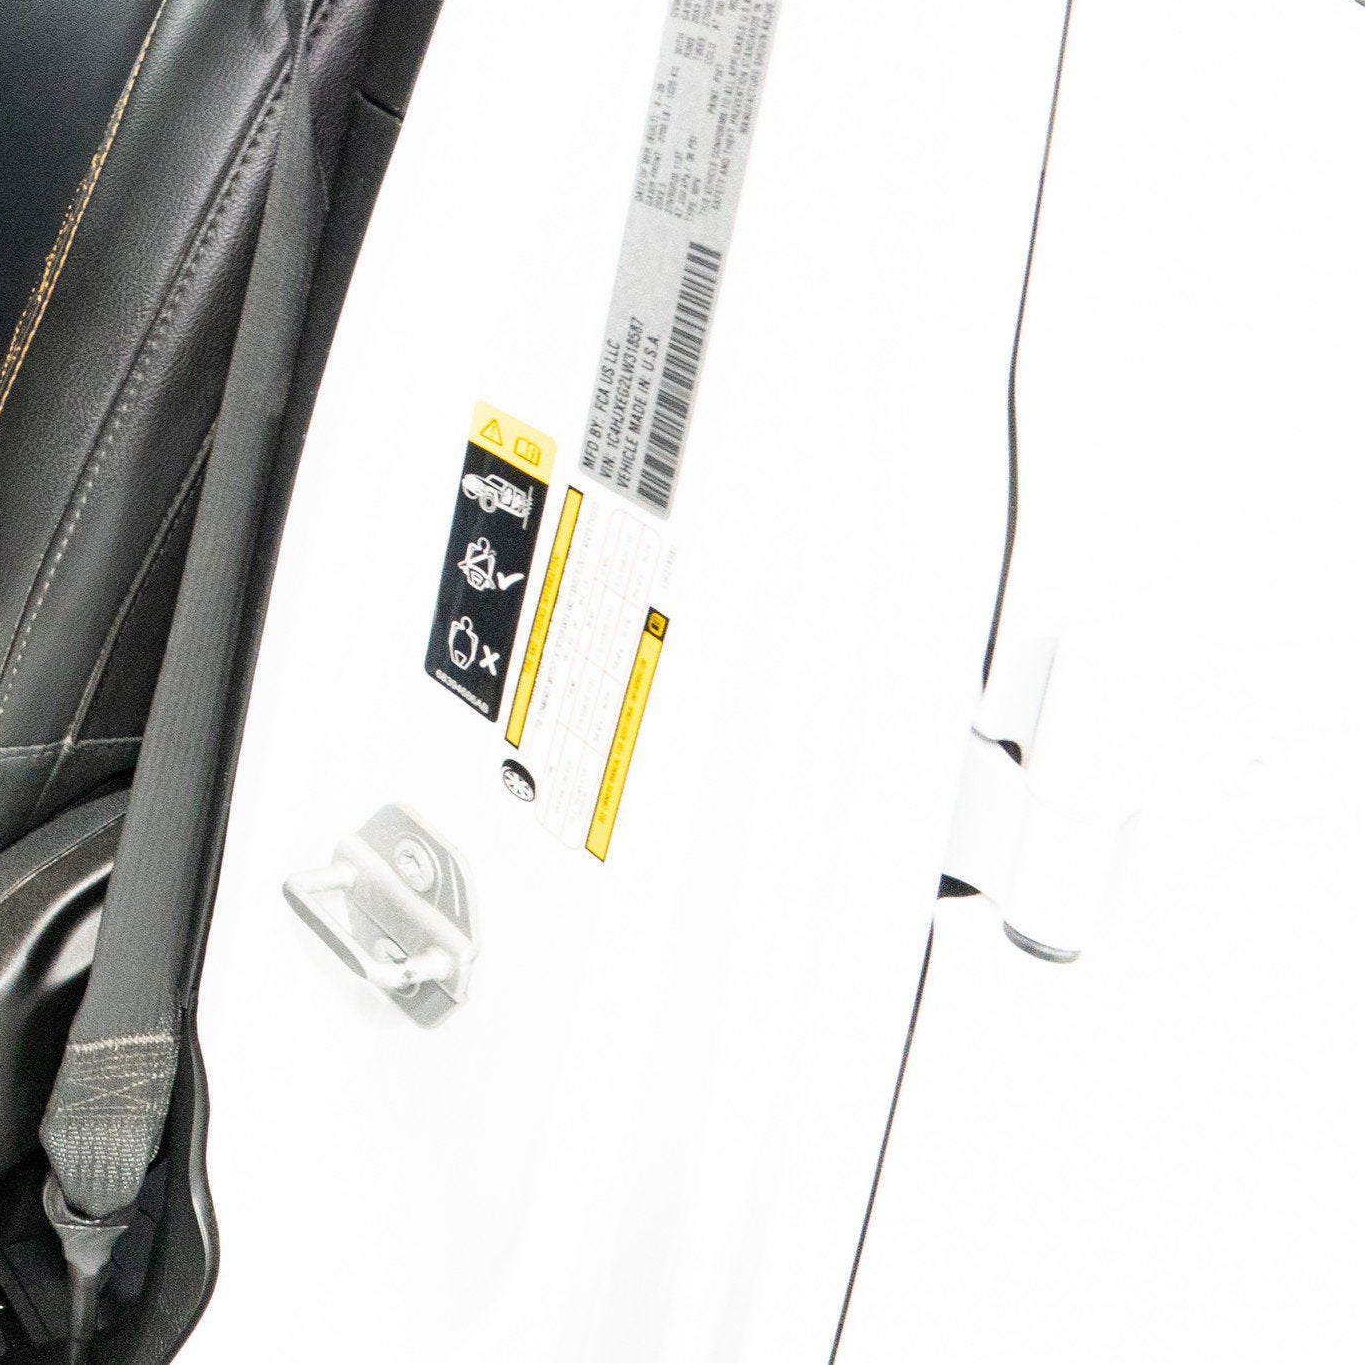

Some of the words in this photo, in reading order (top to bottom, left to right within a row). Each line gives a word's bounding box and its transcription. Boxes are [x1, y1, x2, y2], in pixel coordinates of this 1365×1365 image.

[604, 337, 620, 364] LLC
[600, 363, 615, 386] US
[605, 315, 644, 451] 1C4HJXEG2LW318587
[636, 373, 651, 395] IN:
[594, 385, 610, 413] FCA
[589, 414, 604, 440] BY:
[627, 394, 647, 435] MADE
[582, 438, 599, 471] MFD
[599, 450, 615, 481] VIN:
[616, 434, 638, 491] VEHICLE
